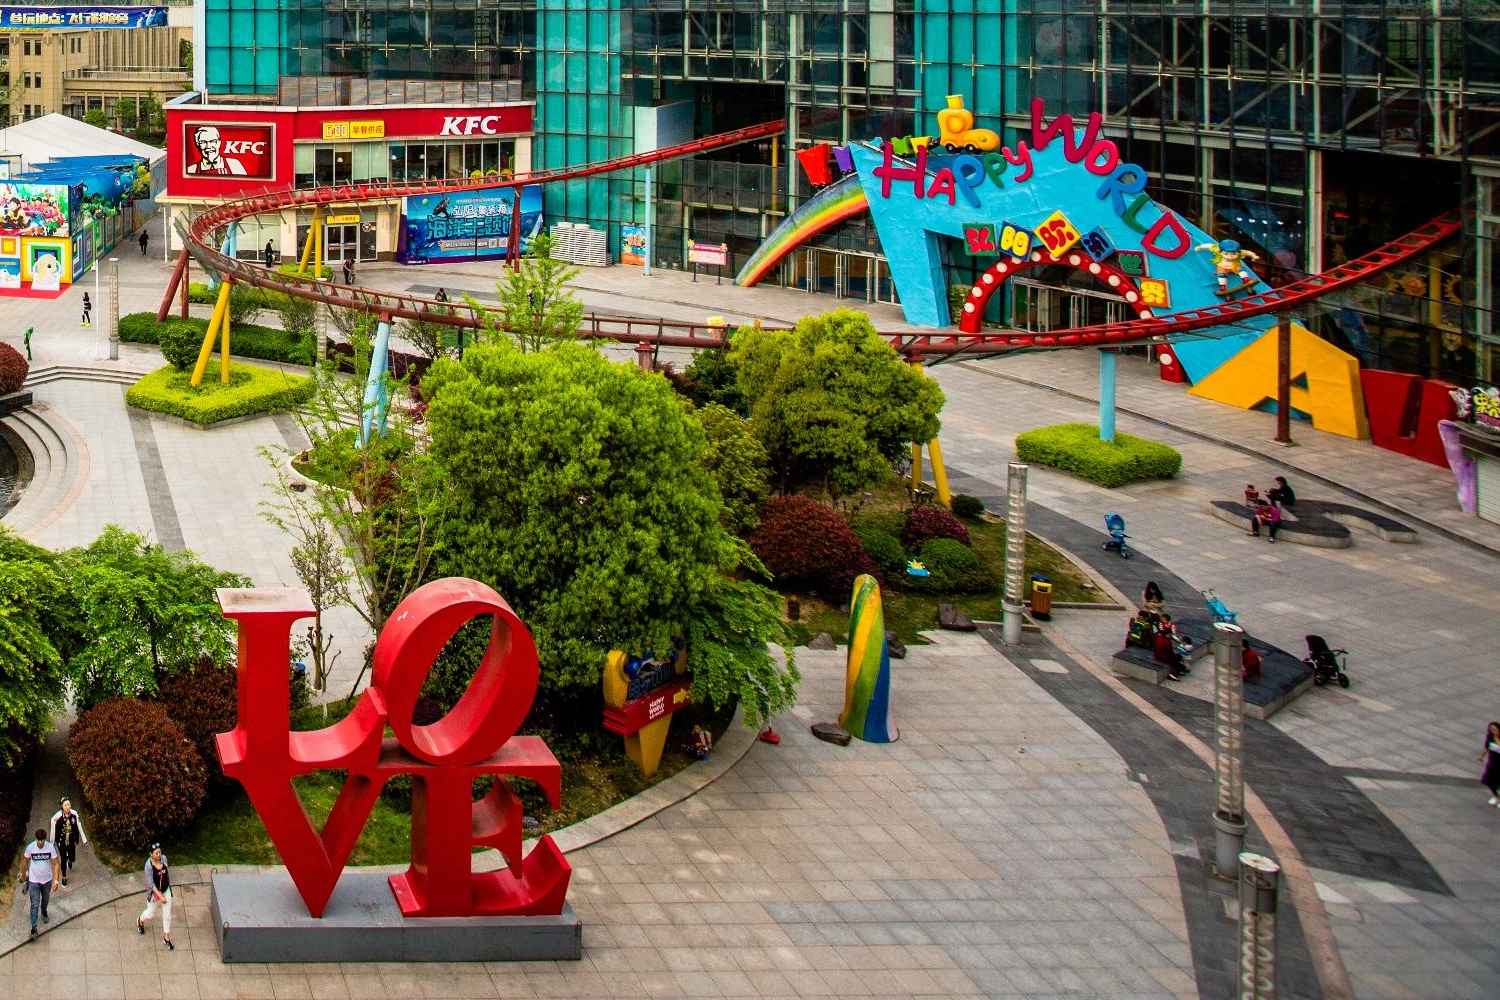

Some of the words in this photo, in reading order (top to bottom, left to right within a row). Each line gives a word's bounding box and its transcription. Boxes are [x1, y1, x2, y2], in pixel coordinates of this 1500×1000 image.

[353, 124, 384, 135] 早餐供应
[439, 115, 499, 136] KFC
[223, 140, 265, 155] KFC
